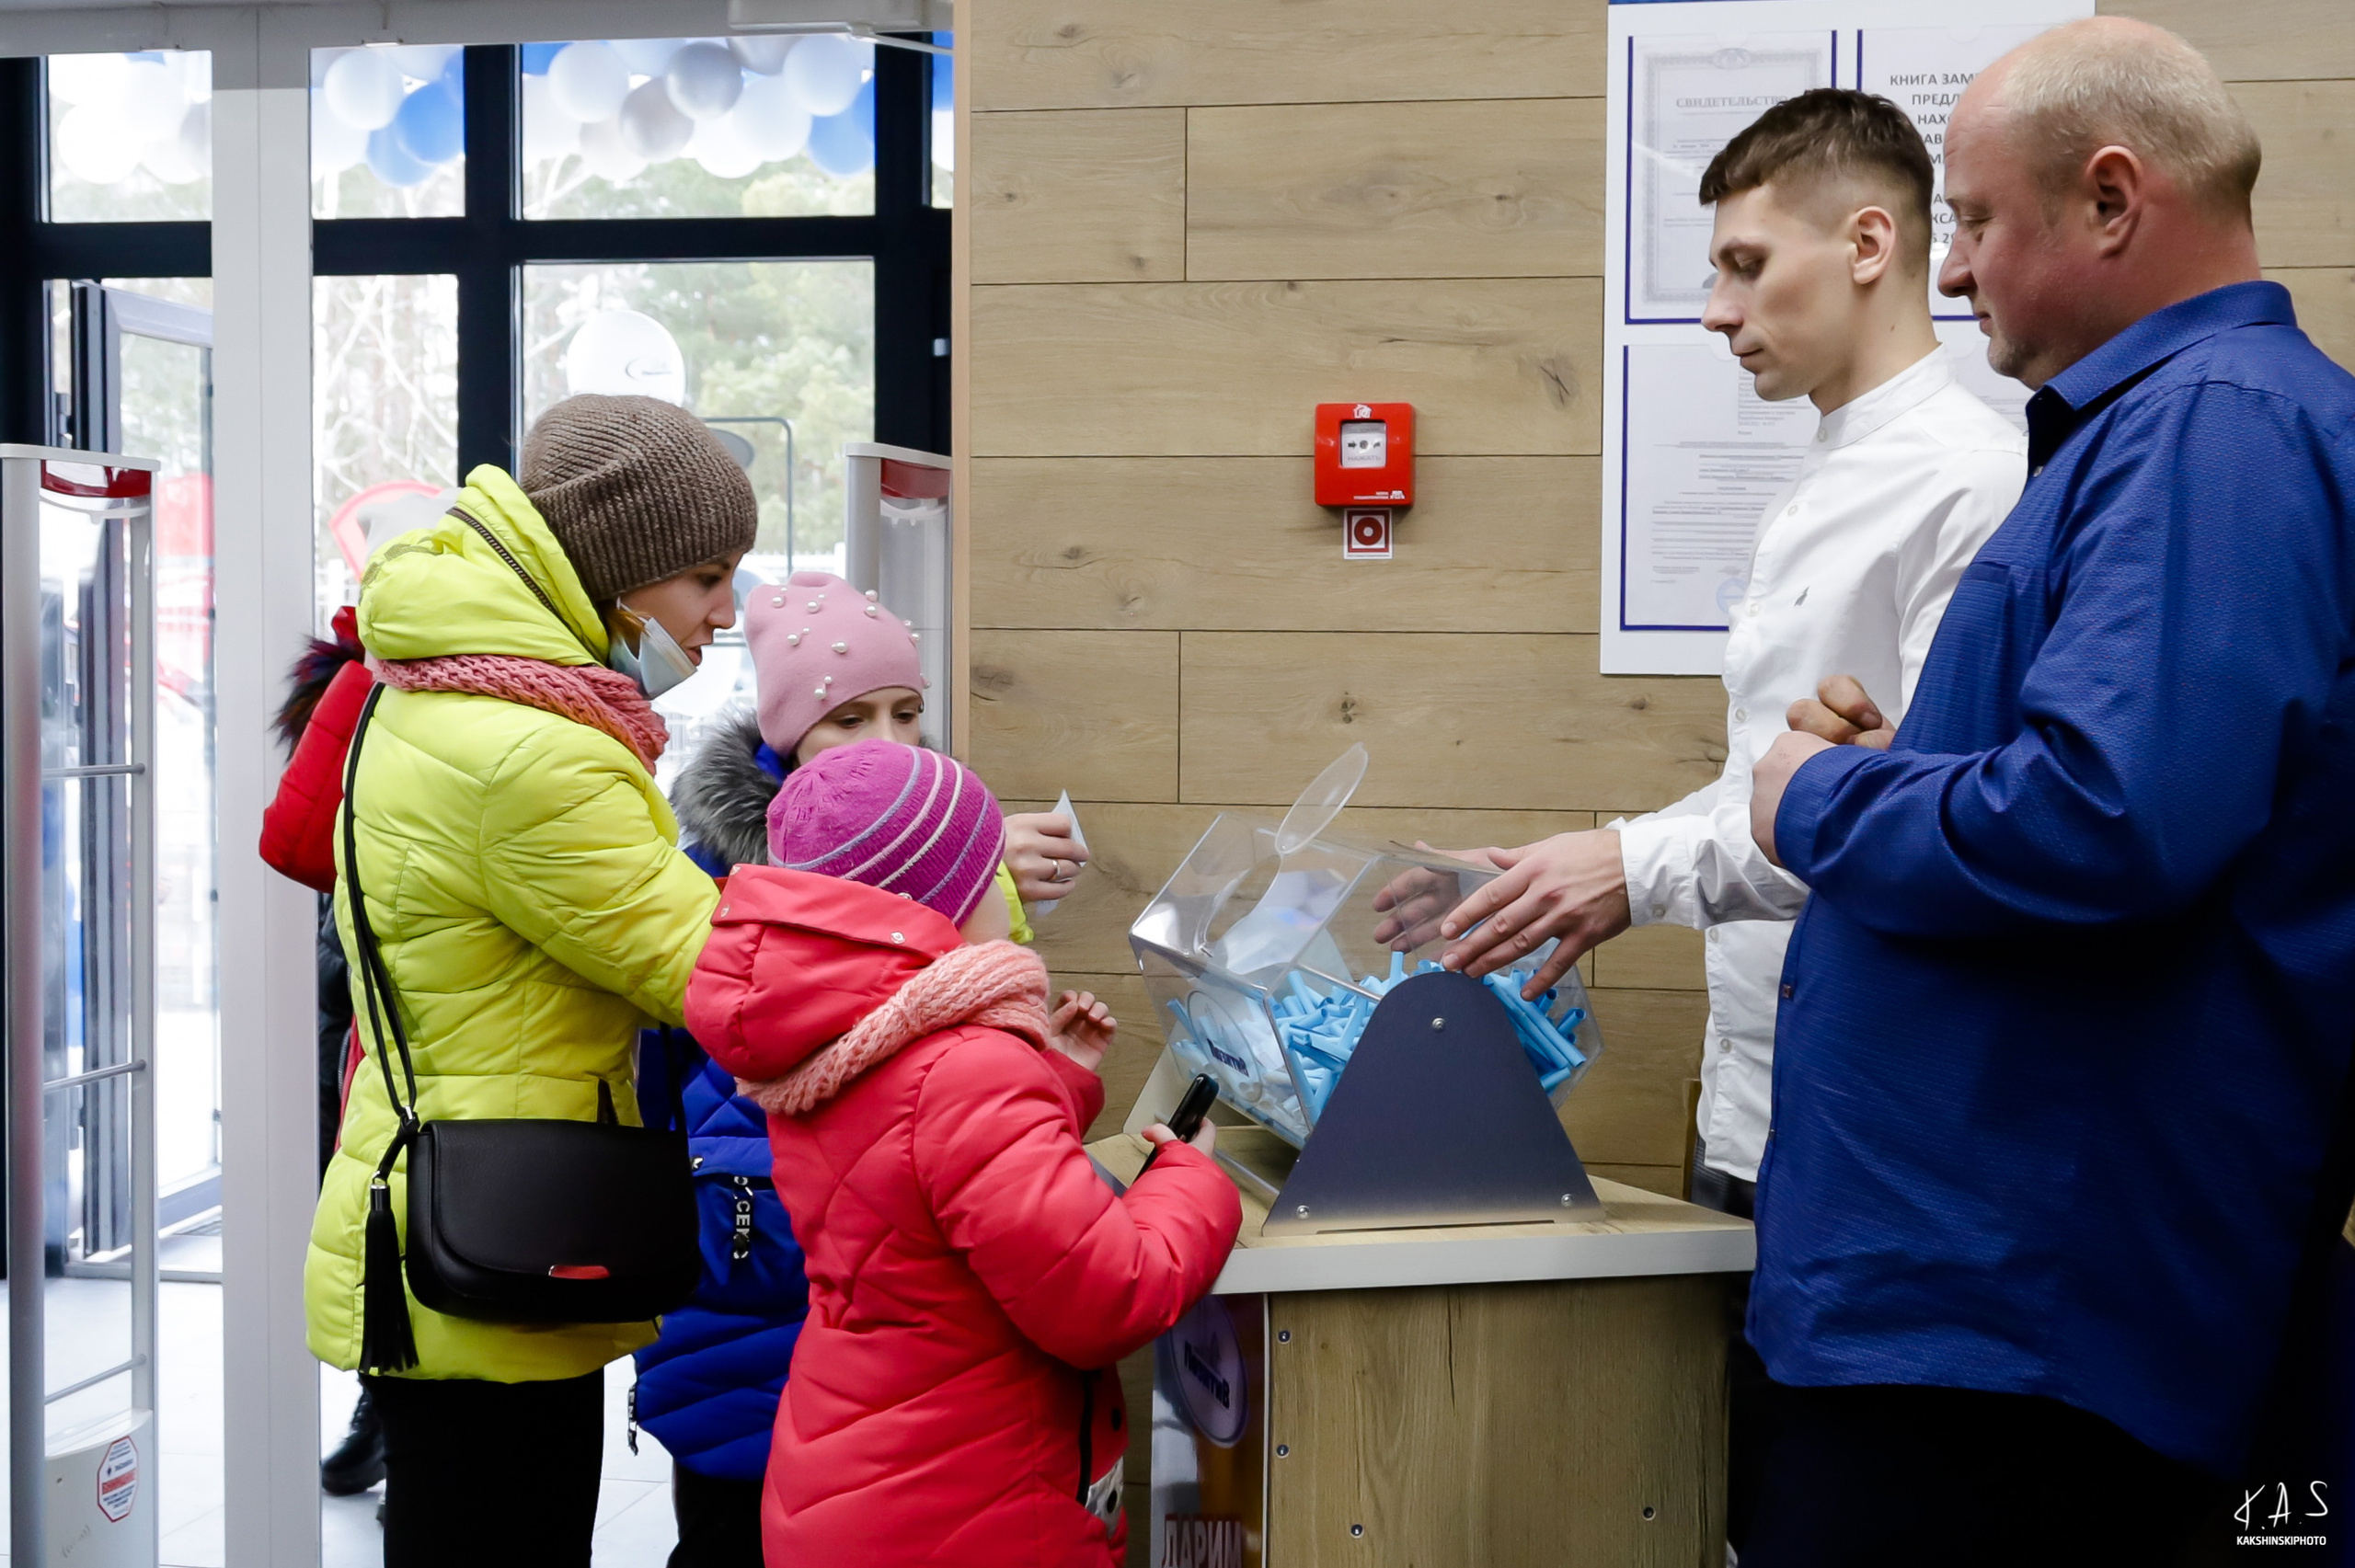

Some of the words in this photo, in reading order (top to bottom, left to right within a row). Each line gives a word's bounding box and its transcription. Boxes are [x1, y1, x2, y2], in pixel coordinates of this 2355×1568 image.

[1890, 74, 1937, 86] КНИГА
[1942, 74, 1979, 85] ЗАМ
[1918, 114, 1949, 124] НАХ
[1163, 1520, 1242, 1568] ДАРИМ
